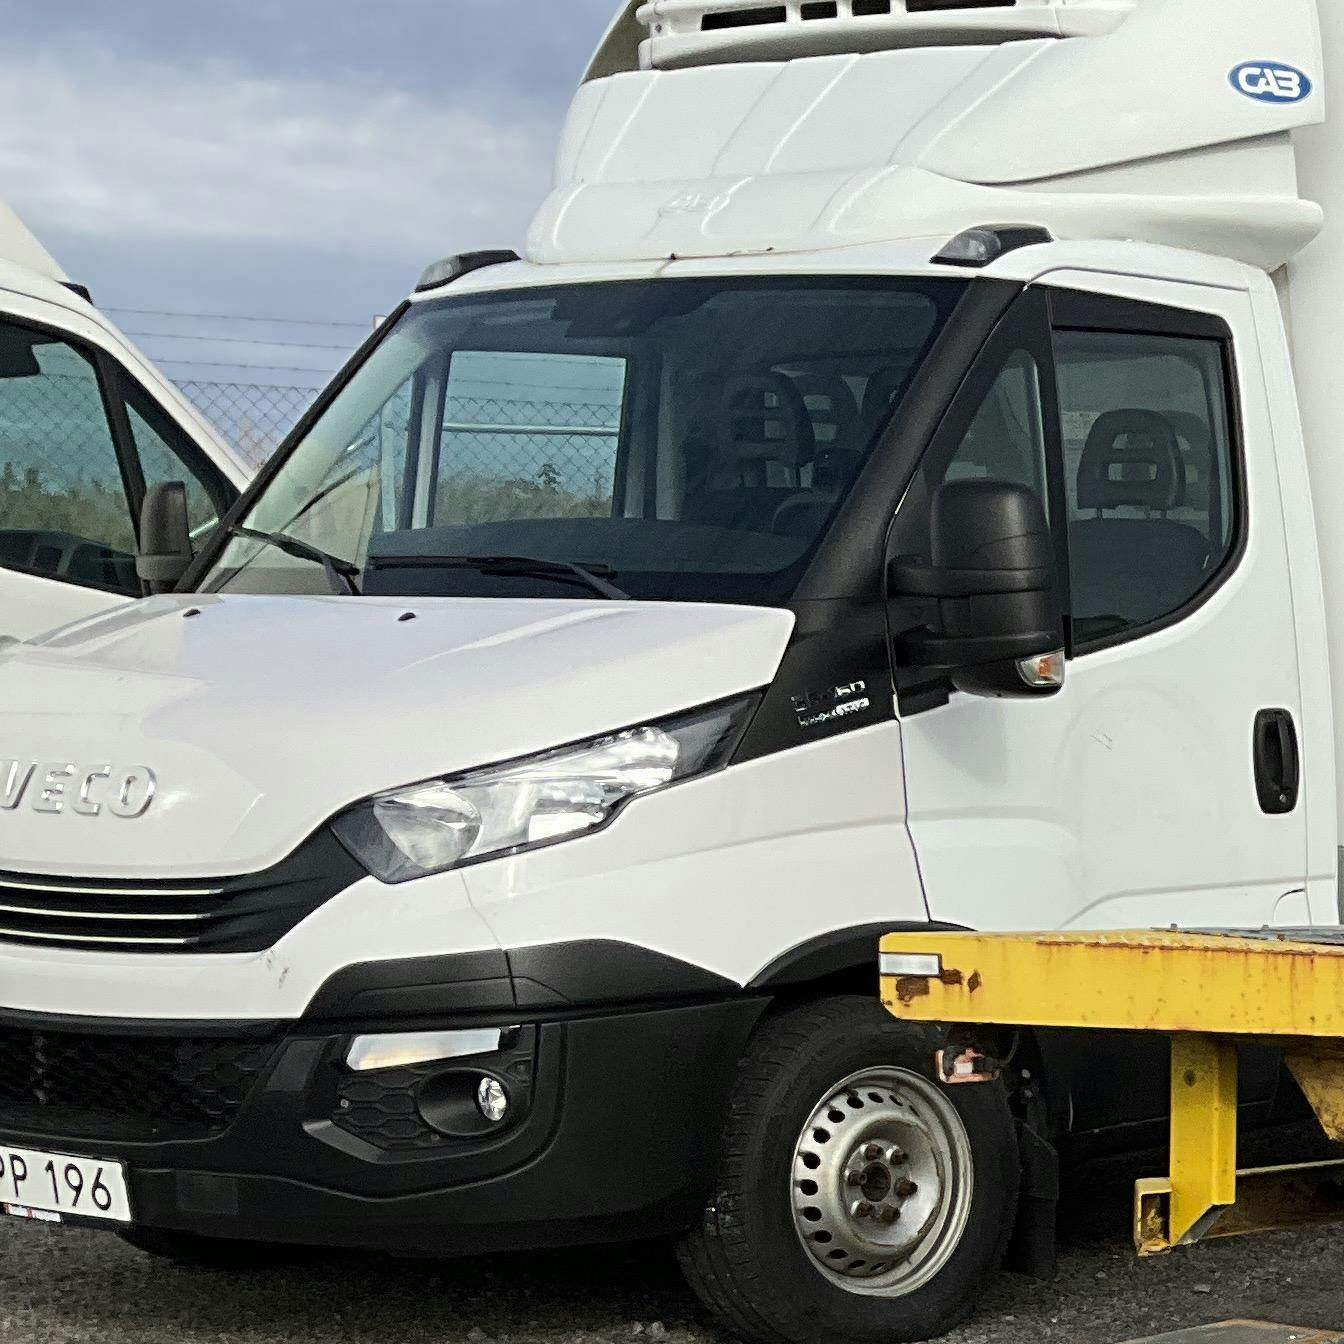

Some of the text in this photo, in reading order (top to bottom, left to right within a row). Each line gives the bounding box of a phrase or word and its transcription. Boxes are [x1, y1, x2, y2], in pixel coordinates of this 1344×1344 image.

[1238, 66, 1301, 98] CAB
[0, 1153, 112, 1211] P 196
